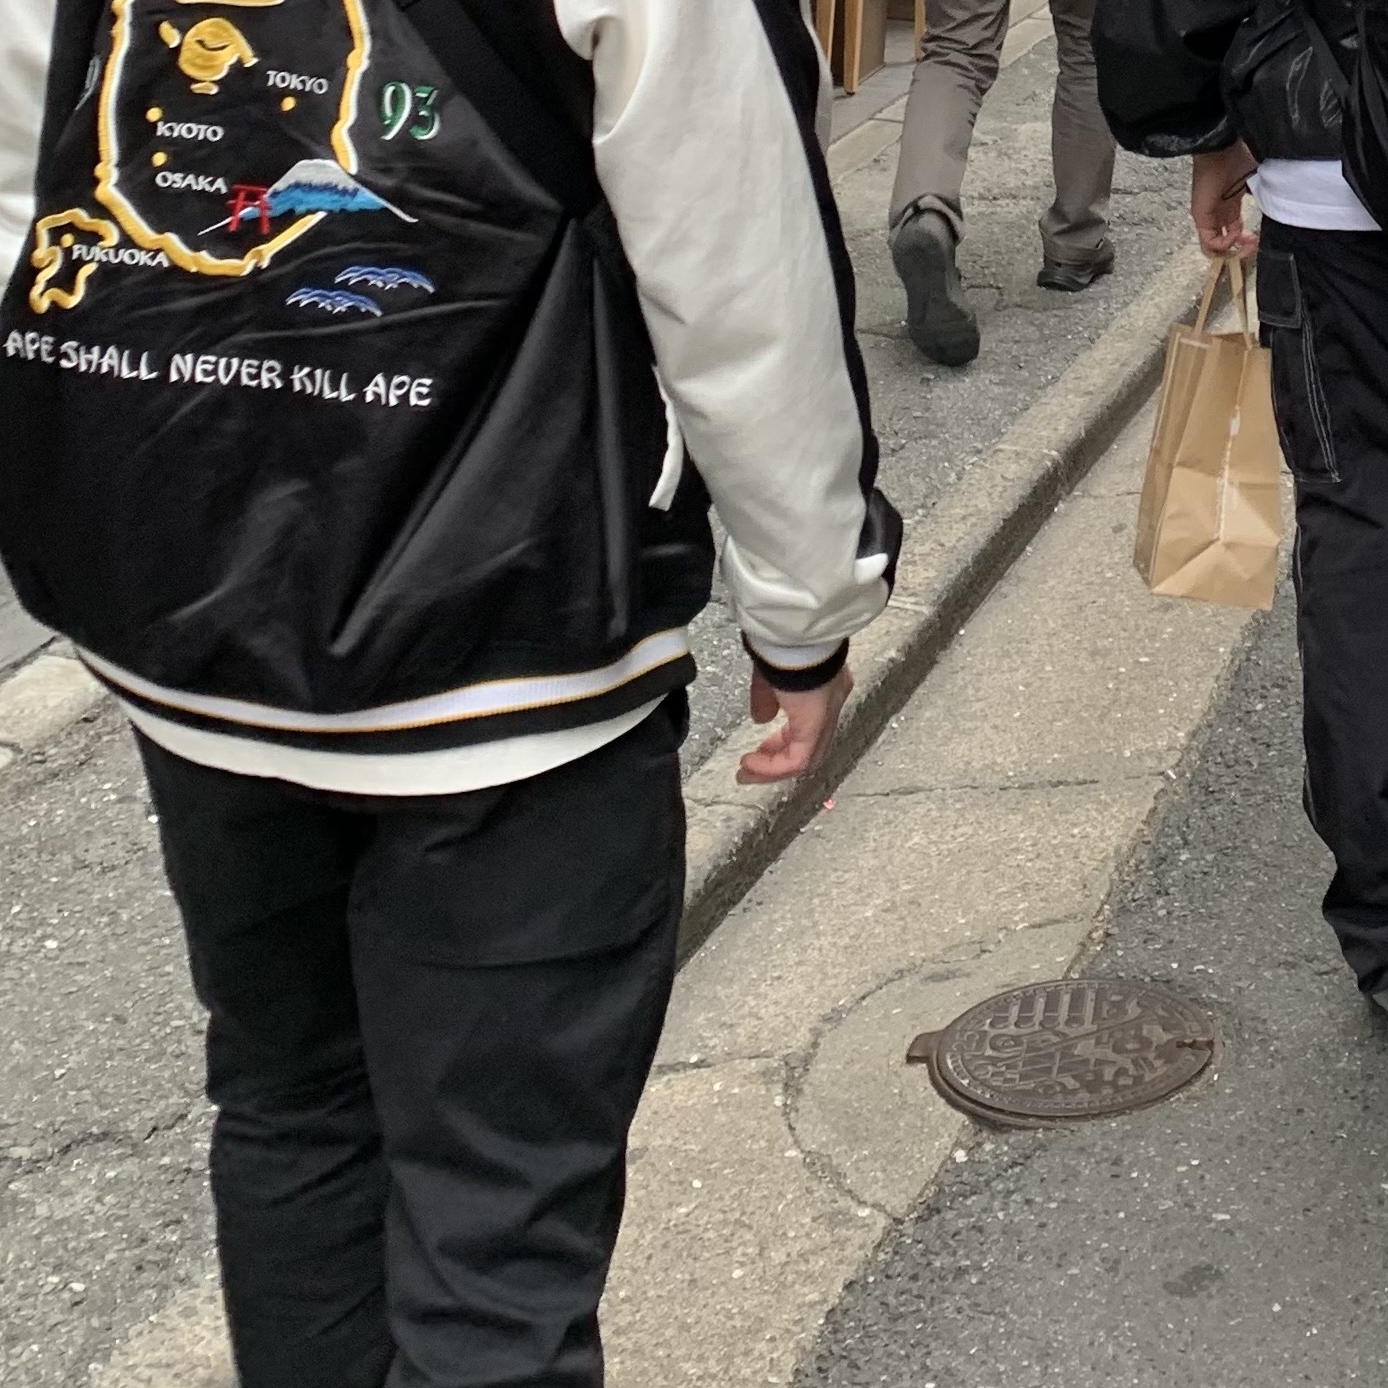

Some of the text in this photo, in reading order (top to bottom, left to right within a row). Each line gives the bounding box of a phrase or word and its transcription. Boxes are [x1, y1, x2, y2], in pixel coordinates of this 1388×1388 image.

[266, 70, 329, 96] TOKYO
[379, 82, 441, 141] 93
[156, 121, 225, 143] KYOTO
[155, 171, 229, 195] OSAKA
[72, 244, 170, 269] FUKUOKA
[3, 330, 433, 408] APE SHALL NEVER KILL APE
